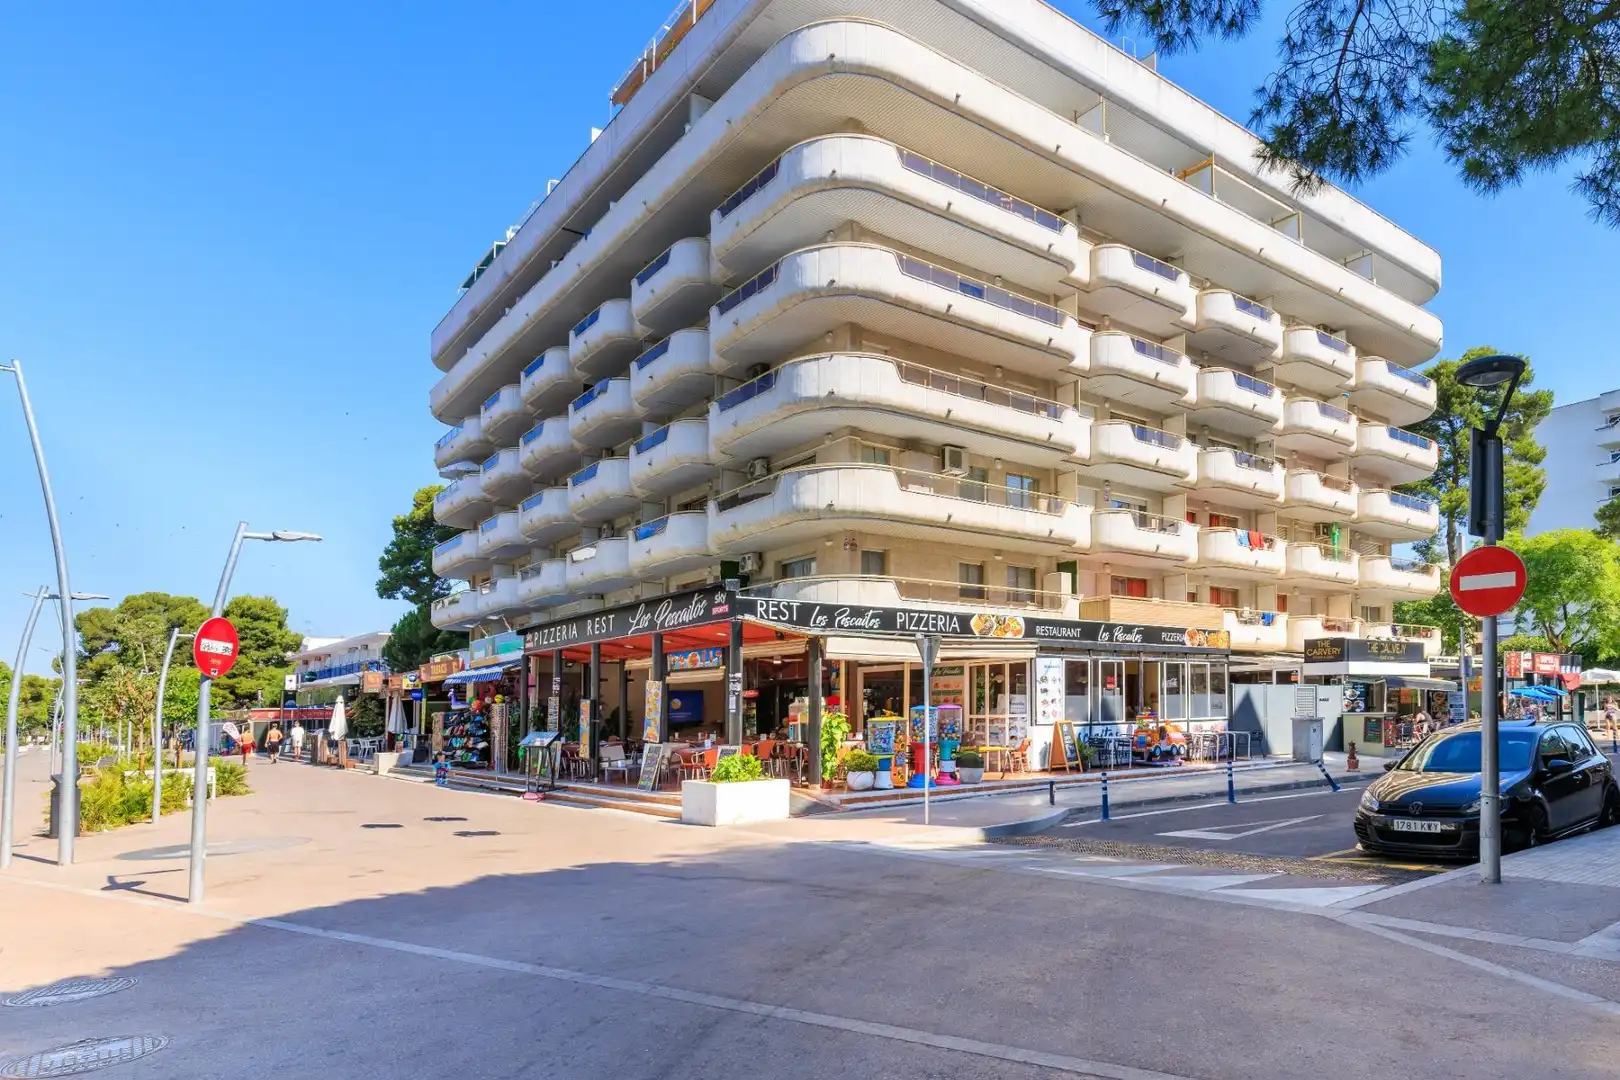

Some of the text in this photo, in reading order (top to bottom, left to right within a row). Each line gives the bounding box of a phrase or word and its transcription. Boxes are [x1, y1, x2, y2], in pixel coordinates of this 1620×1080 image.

[714, 591, 727, 604] sky
[534, 592, 707, 647] PIZZERIA REST Los Pescaitos
[756, 600, 960, 632] REST Los Pescaitos PIZZERIA
[1035, 625, 1081, 638] RESTAURANT
[1098, 624, 1110, 642] Los
[1161, 631, 1186, 643] PIZZERIA
[1316, 640, 1331, 648] THE
[1306, 647, 1342, 656] CARVERY
[1397, 821, 1416, 830] 1781
